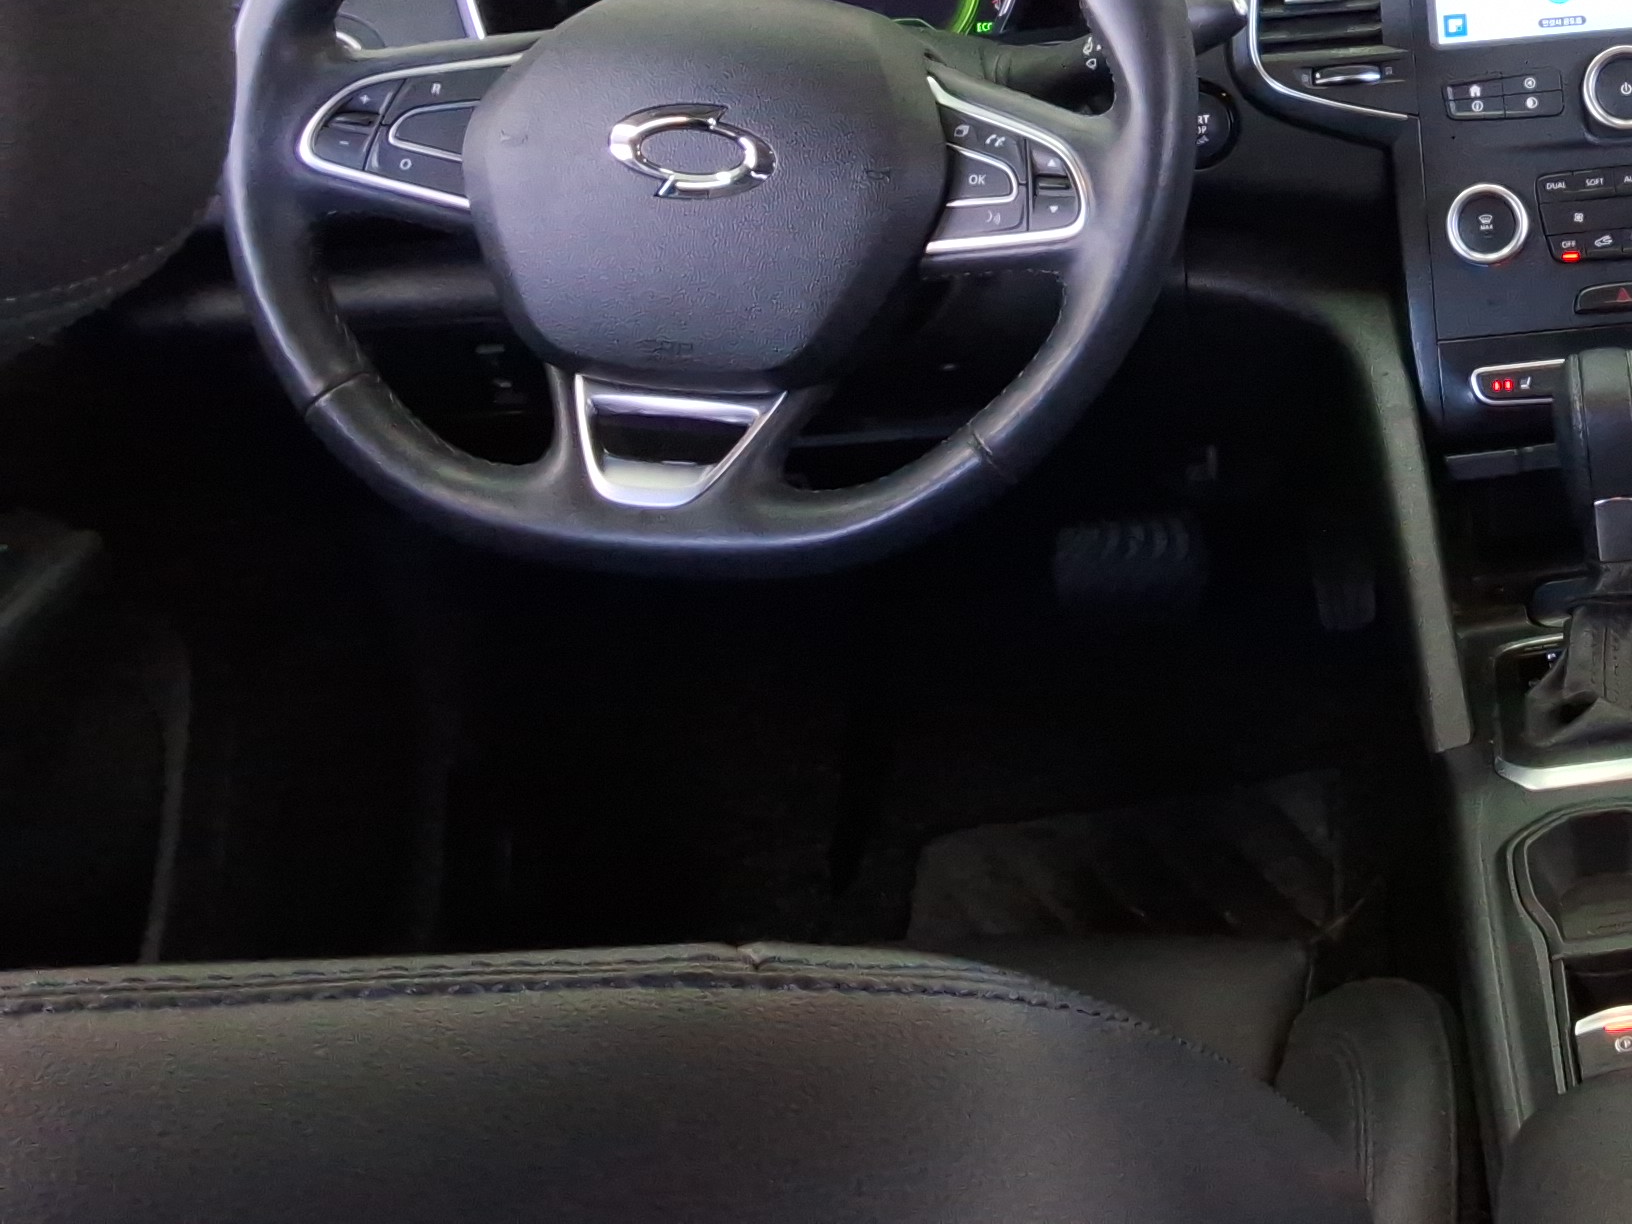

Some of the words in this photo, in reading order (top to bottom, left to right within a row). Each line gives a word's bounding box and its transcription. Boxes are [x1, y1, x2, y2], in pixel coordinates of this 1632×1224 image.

[968, 174, 986, 185] OK
[1585, 177, 1604, 187] SOFT
[1546, 182, 1566, 190] DUAL
[1561, 240, 1576, 249] OFF
